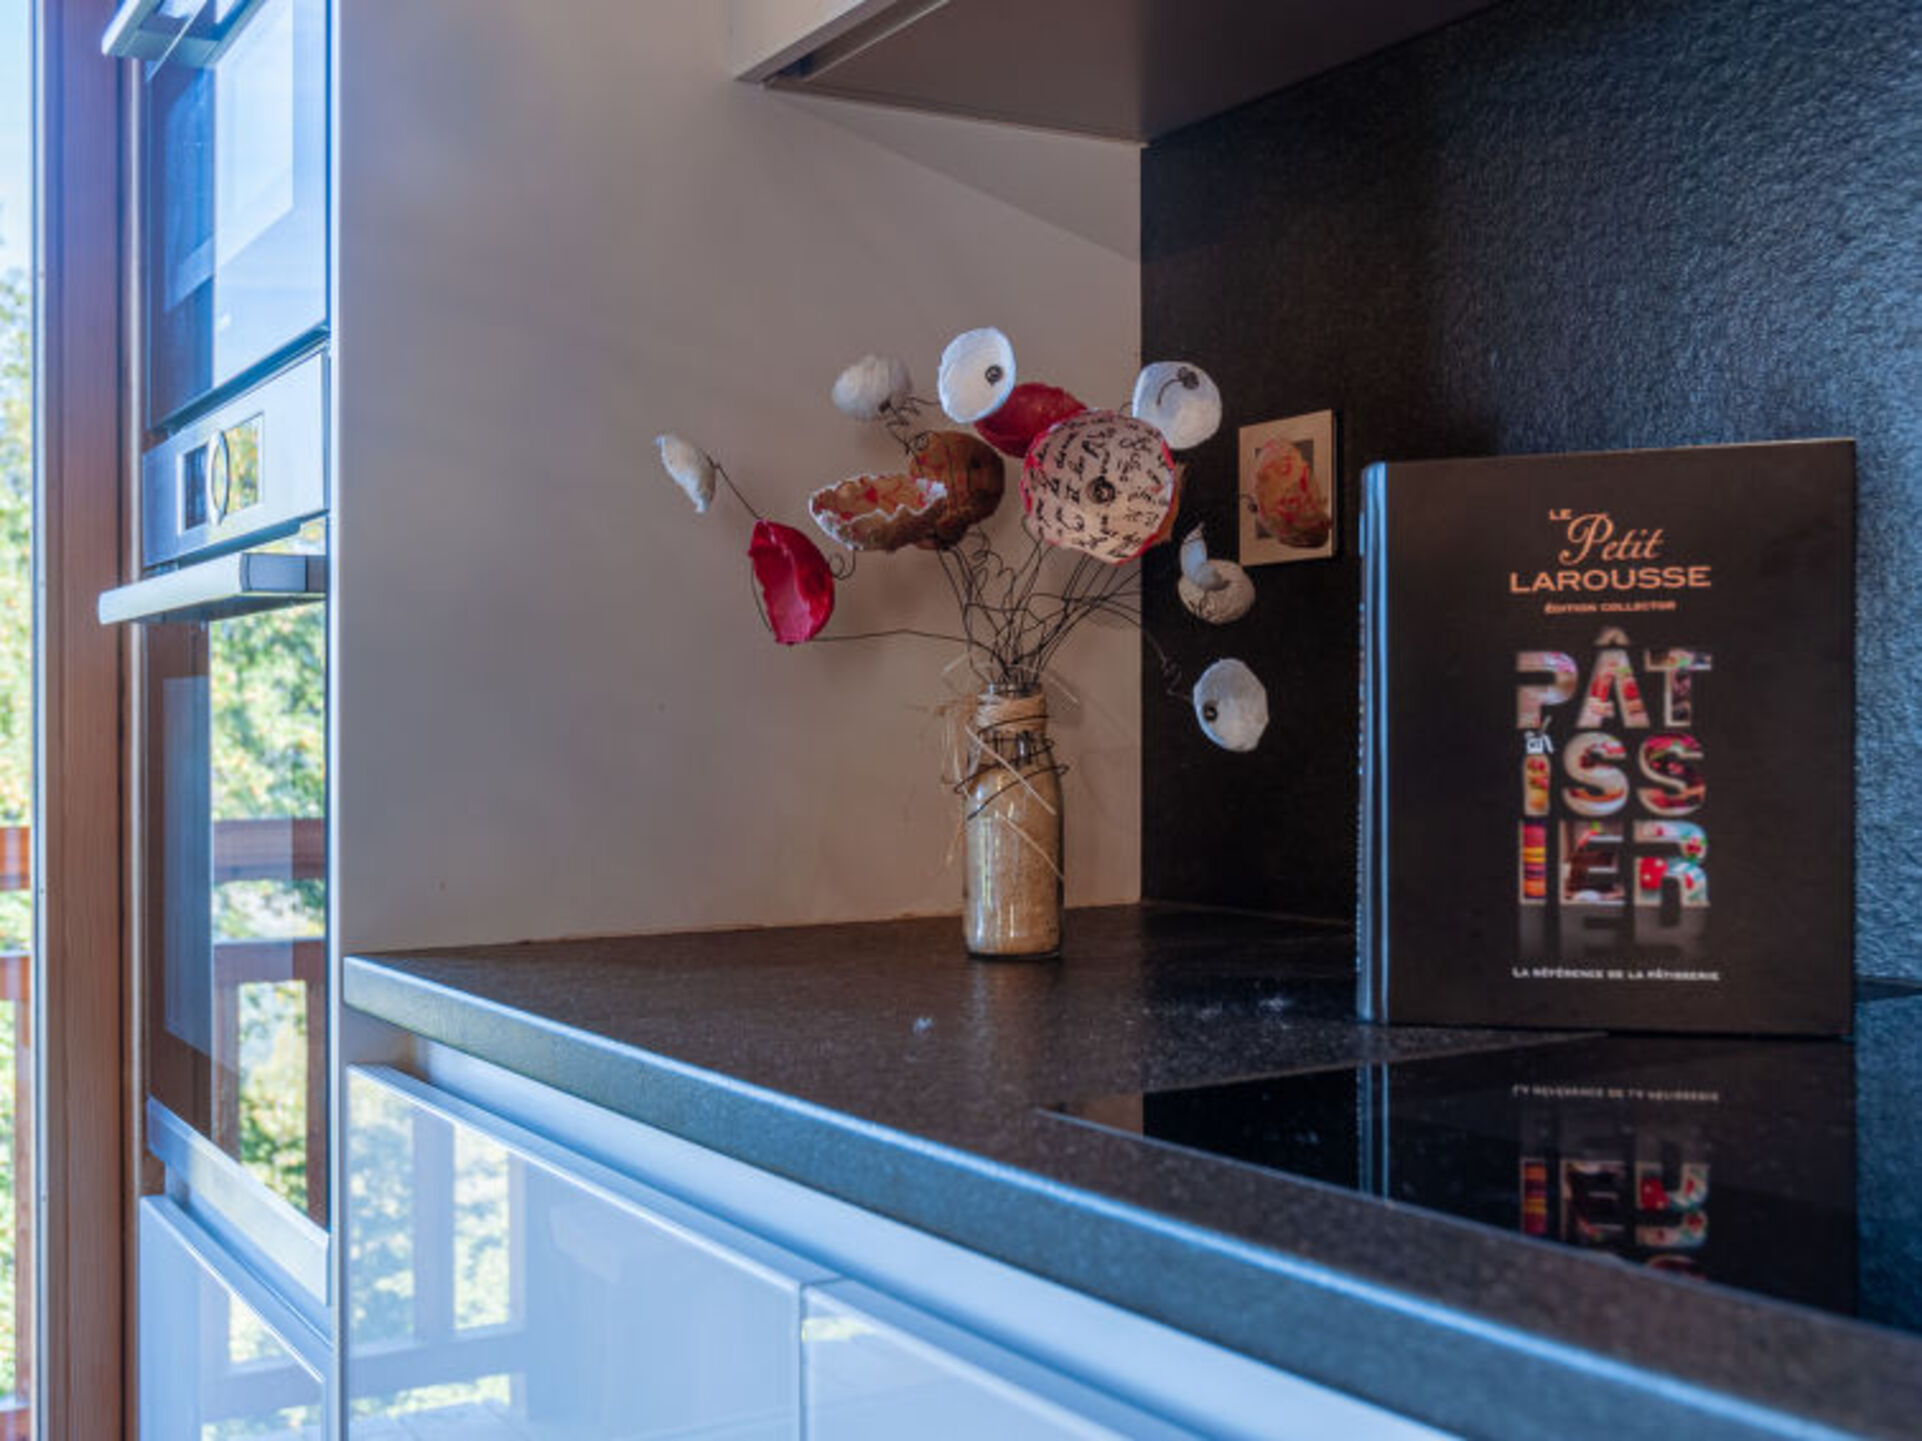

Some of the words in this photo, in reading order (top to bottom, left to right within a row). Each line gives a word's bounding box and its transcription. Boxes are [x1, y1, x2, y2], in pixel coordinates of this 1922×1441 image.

[1548, 508, 1573, 521] LE
[1558, 512, 1664, 566] Petit
[1508, 565, 1712, 593] LAROUSSE
[1600, 600, 1677, 613] COLLECTOR
[1515, 626, 1712, 729] PÂT
[1518, 818, 1711, 907] IER
[1511, 966, 1529, 979] LA
[1627, 969, 1644, 981] LA
